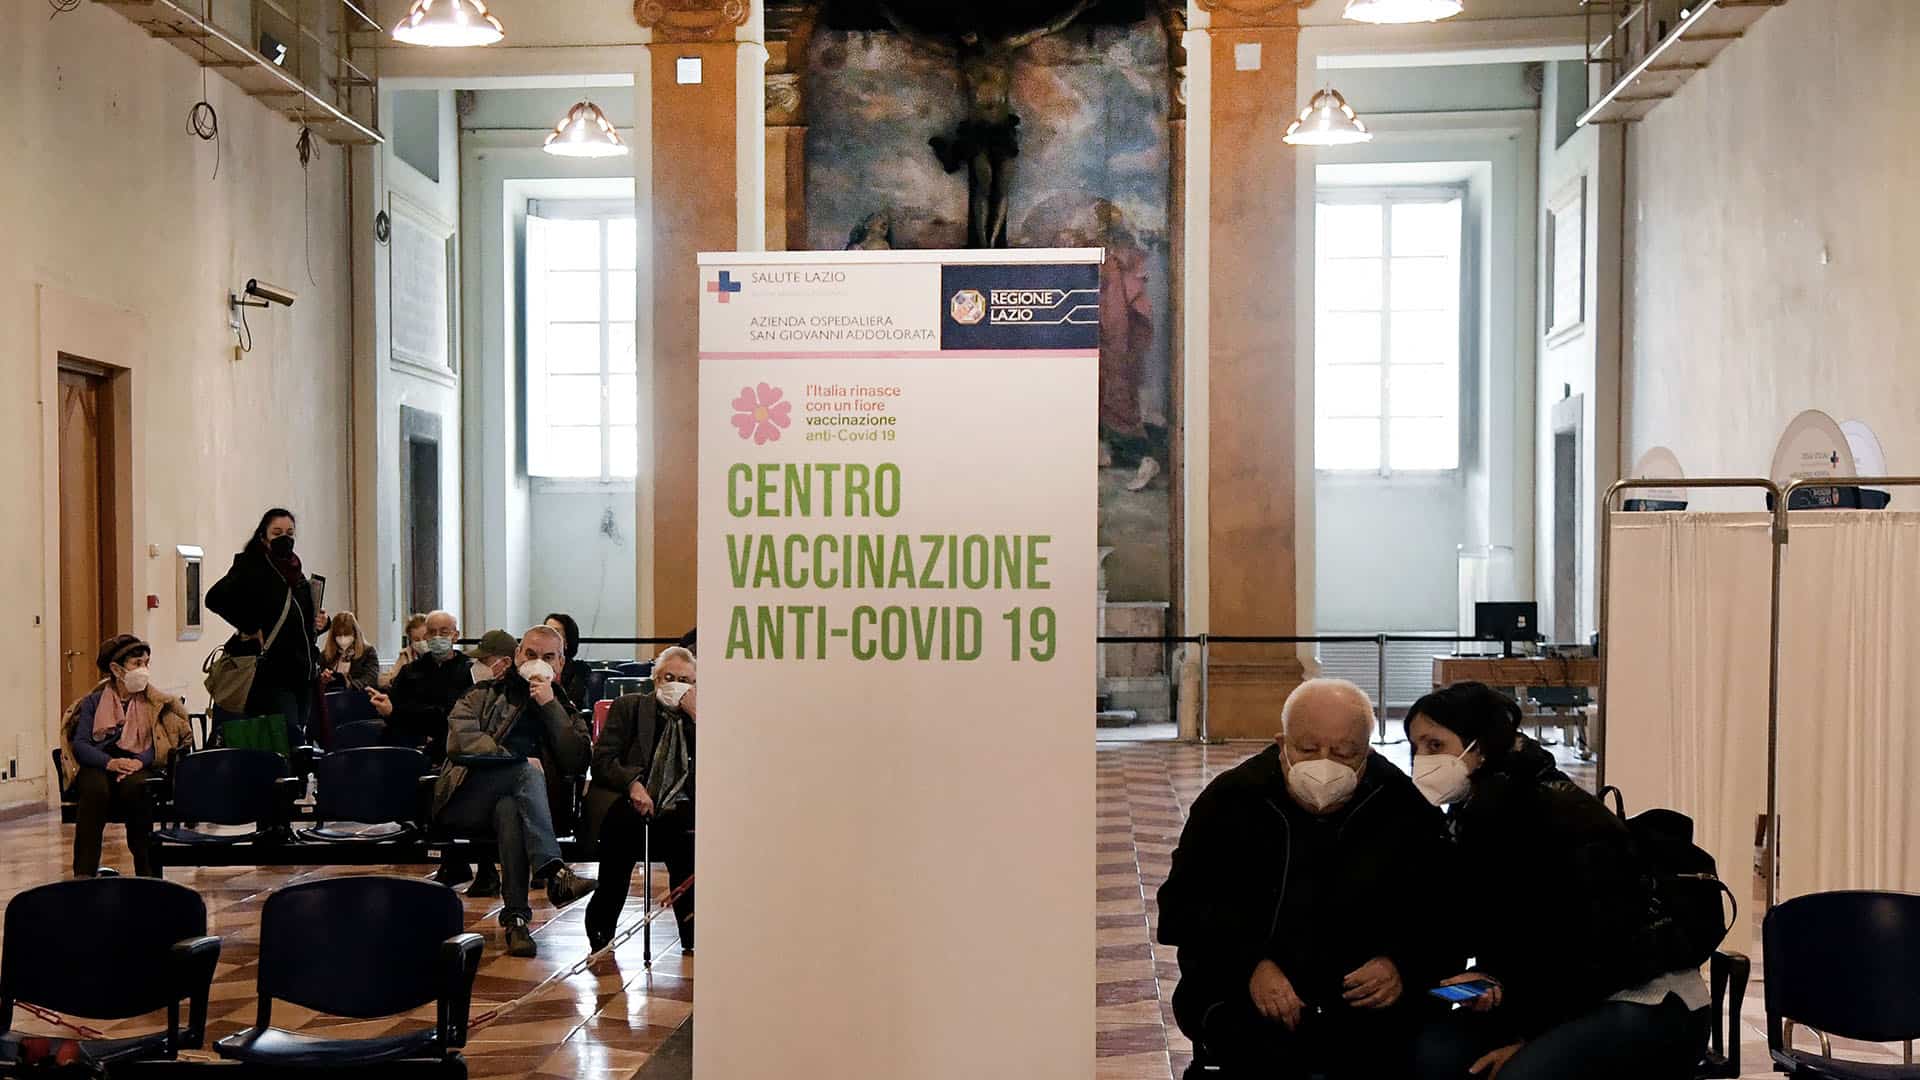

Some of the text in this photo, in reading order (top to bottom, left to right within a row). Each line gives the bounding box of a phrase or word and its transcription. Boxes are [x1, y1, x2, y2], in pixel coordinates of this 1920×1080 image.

[752, 271, 846, 284] SALUTE LAZIO
[991, 292, 1053, 305] REGIONE
[991, 308, 1033, 321] LAZIO
[750, 315, 894, 328] AZIENDA OSPEDALIERA
[750, 329, 936, 341] SAN GIOVANNI ADDOLORATA
[850, 385, 902, 397] rinasce
[806, 399, 886, 412] con un fiore
[806, 413, 897, 426] vaccinazione
[806, 429, 897, 441] anti-Covid 19
[728, 463, 901, 517] CENTRO
[726, 534, 1052, 589] VACCINAZIONE
[725, 605, 1057, 662] ANTI-COVID 19
